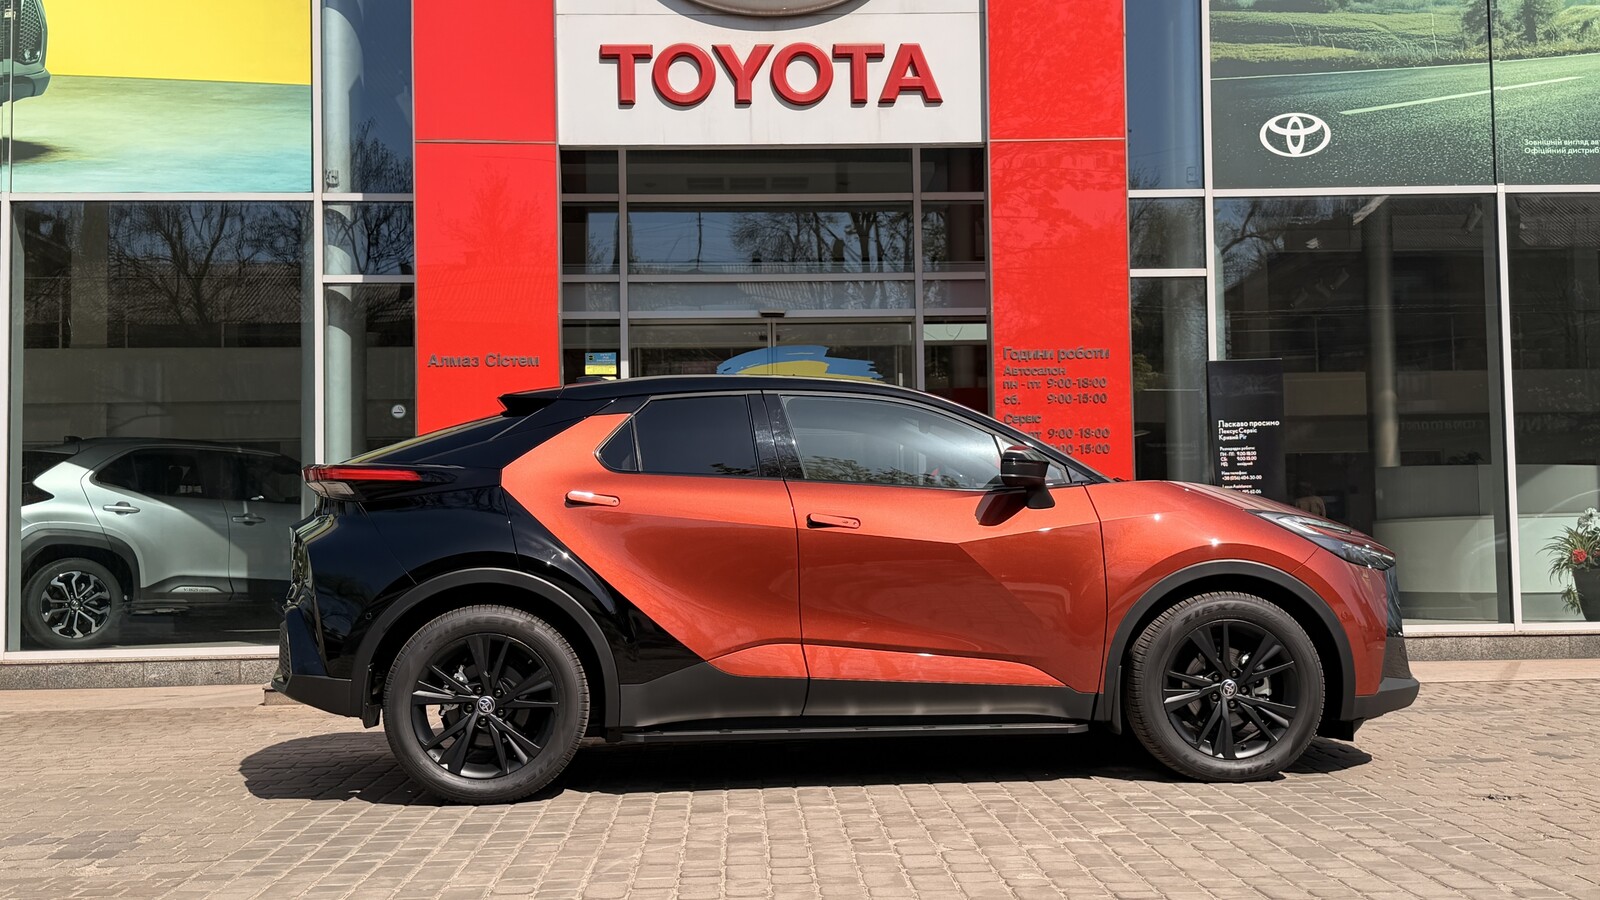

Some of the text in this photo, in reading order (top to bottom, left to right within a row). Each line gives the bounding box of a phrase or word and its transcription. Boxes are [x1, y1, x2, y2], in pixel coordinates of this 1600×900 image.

[599, 42, 943, 107] TOYOTA
[1524, 138, 1563, 146] Зовнішній
[1564, 139, 1589, 147] вигляд
[1524, 147, 1567, 155] Офіційний
[1003, 346, 1110, 363] Години роботи
[427, 353, 540, 368] Алмаз Сістем
[1003, 366, 1066, 377] Автосалон
[1003, 380, 1019, 389] пн
[1047, 378, 1108, 389] 9:00-18:00
[1003, 393, 1108, 406] сб. 9:00-15:00
[1003, 414, 1042, 426] Сервіс
[1218, 420, 1280, 428] Ласкаво просимо
[1048, 428, 1110, 439] 9:00-18:00
